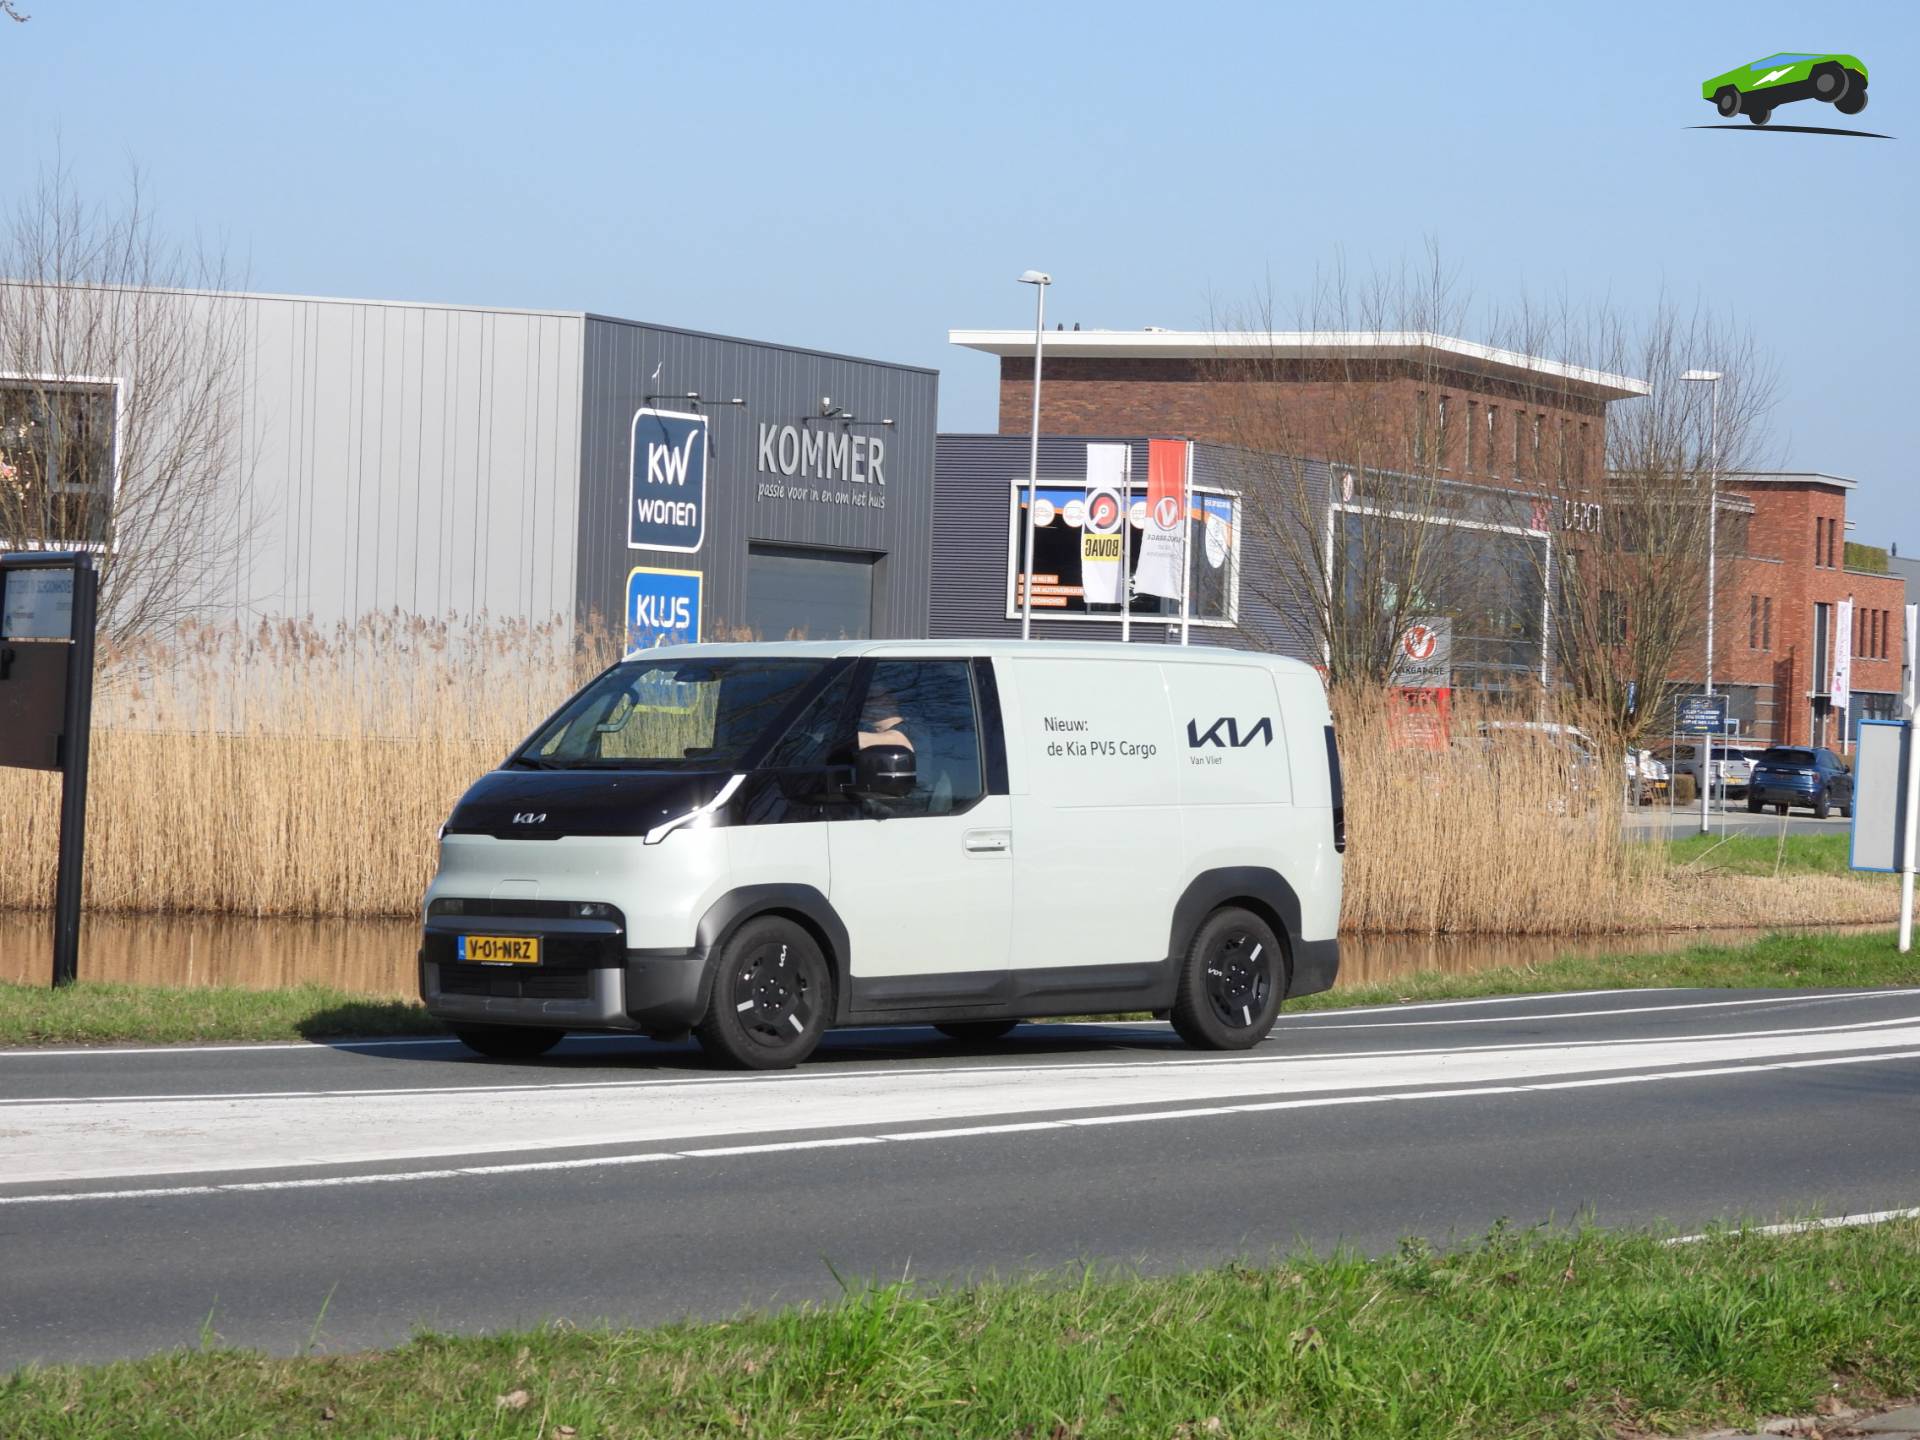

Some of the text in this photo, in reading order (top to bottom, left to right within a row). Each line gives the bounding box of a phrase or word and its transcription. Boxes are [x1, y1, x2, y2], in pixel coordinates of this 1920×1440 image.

[648, 429, 698, 486] KW
[758, 422, 886, 486] KOMMER
[758, 480, 885, 509] passie voor in en om het huis
[638, 499, 696, 527] WONEN
[637, 594, 689, 629] KLUS
[1044, 716, 1089, 732] Nieuw:
[1187, 717, 1274, 748] KIA
[1047, 741, 1157, 759] de Kia PV5 Cargo
[1190, 756, 1222, 765] Van Vliet
[512, 812, 547, 824] KIA
[469, 938, 531, 960] V-01-NRZ
